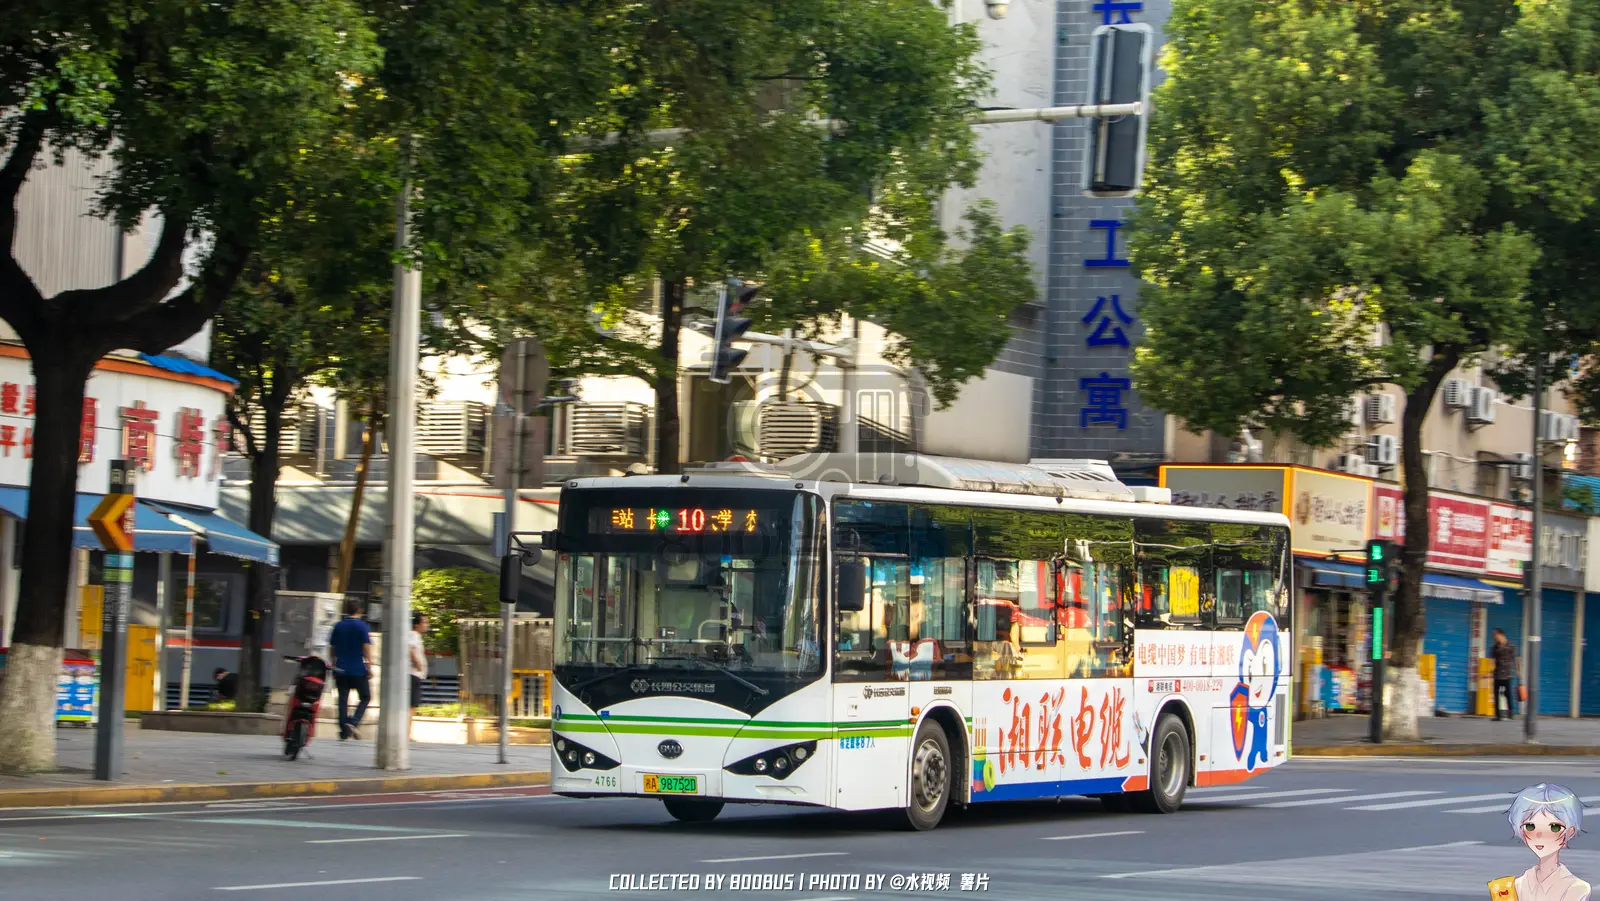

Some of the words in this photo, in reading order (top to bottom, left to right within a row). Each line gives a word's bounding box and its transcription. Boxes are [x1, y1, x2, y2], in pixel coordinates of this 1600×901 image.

[677, 508, 706, 531] 10
[1138, 643, 1186, 665] 电缆中国梦
[999, 686, 1131, 775] 湘联电缆
[595, 775, 617, 787] 4766
